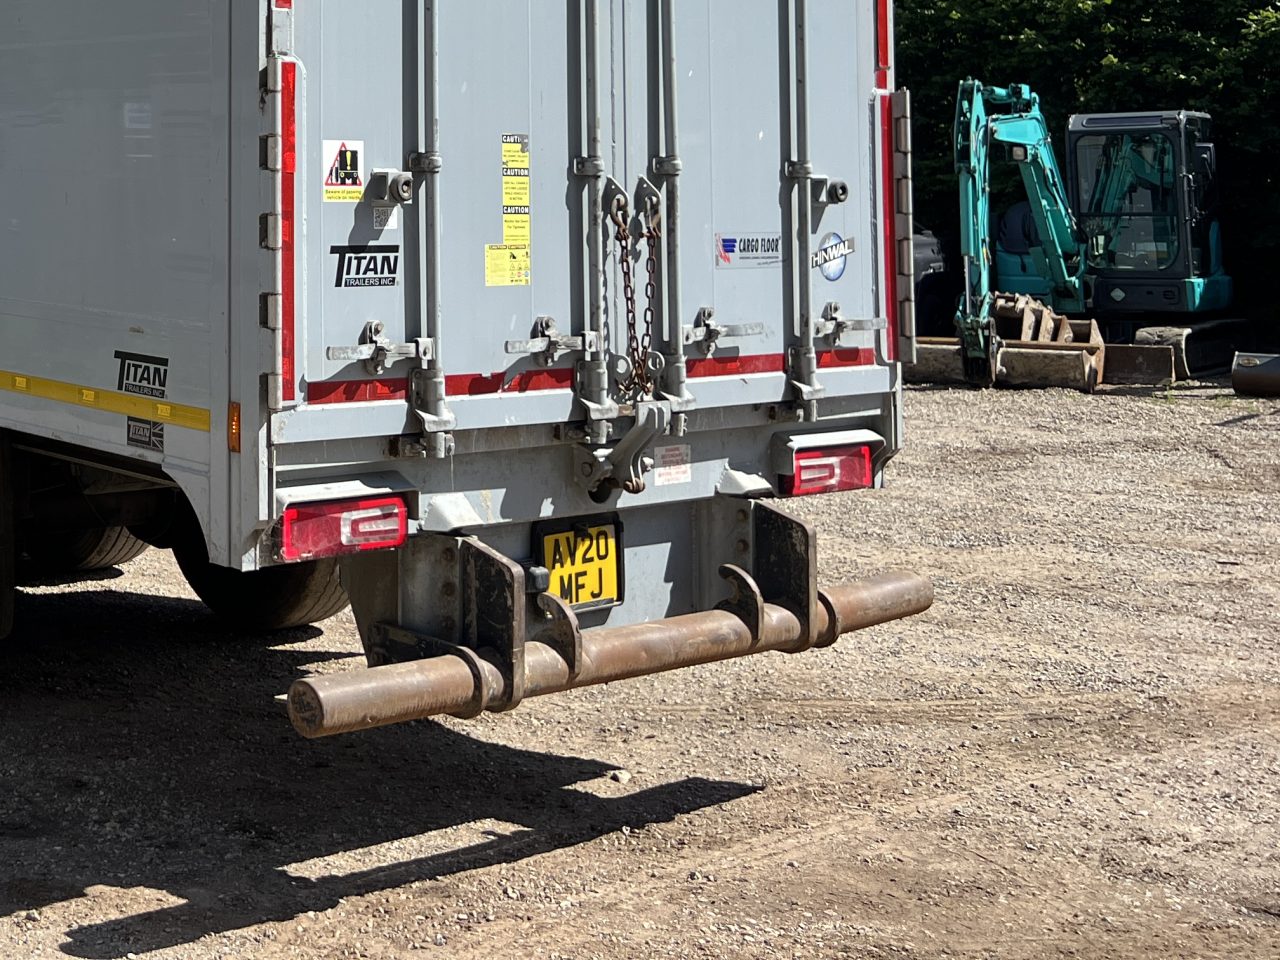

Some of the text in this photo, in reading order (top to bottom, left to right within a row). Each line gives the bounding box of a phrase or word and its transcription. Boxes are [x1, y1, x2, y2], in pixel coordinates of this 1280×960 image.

[503, 168, 528, 176] CAUTION
[503, 206, 529, 214] CAUTION
[738, 238, 779, 253] CARGO FLOOR
[329, 244, 400, 288] TITAN
[345, 278, 380, 286] TRAILERS
[113, 350, 169, 391] TITAN
[125, 383, 152, 396] TRAILERS
[128, 421, 150, 438] TITAN
[552, 530, 609, 570] AV20
[559, 567, 603, 604] MFJ
